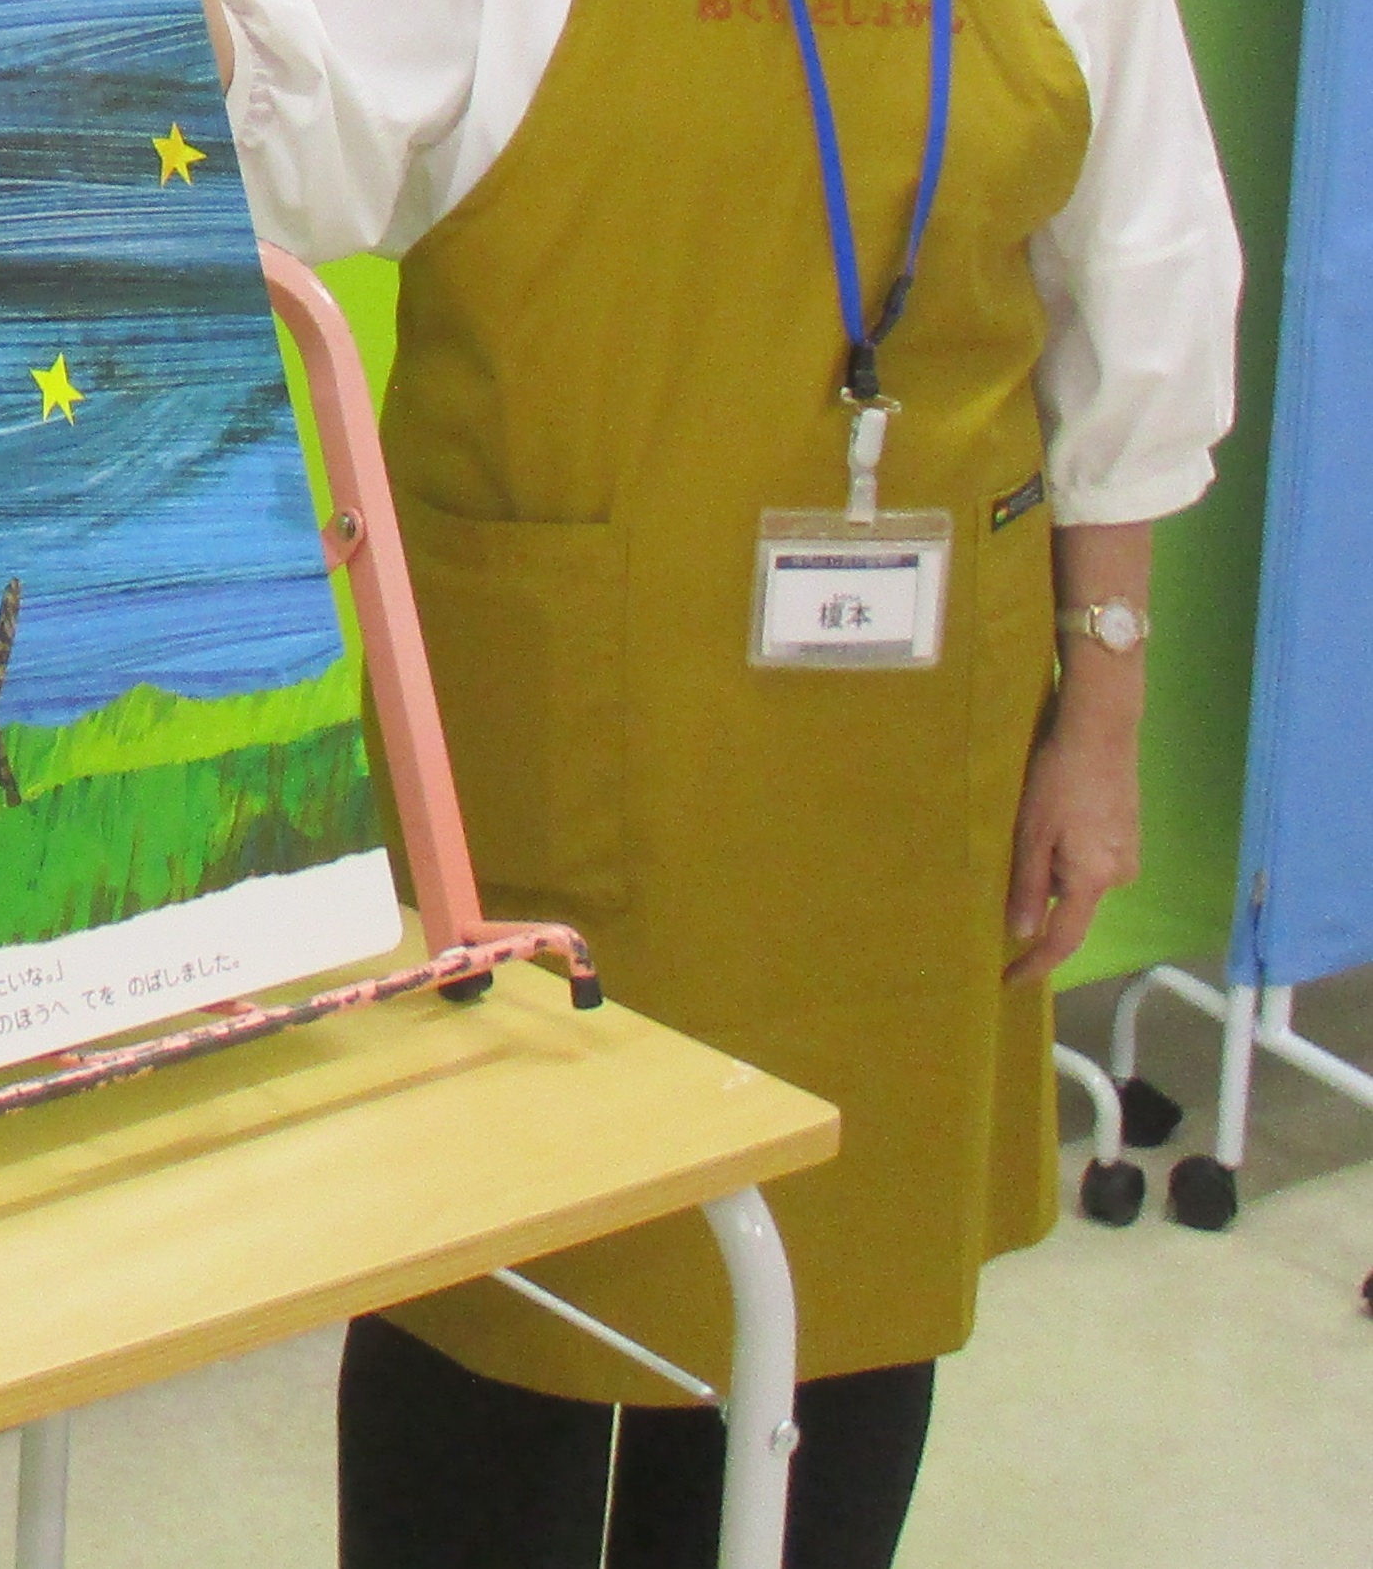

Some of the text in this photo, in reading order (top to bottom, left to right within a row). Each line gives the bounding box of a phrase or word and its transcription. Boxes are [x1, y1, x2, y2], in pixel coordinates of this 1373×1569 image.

[127, 954, 240, 996] のばしました。
